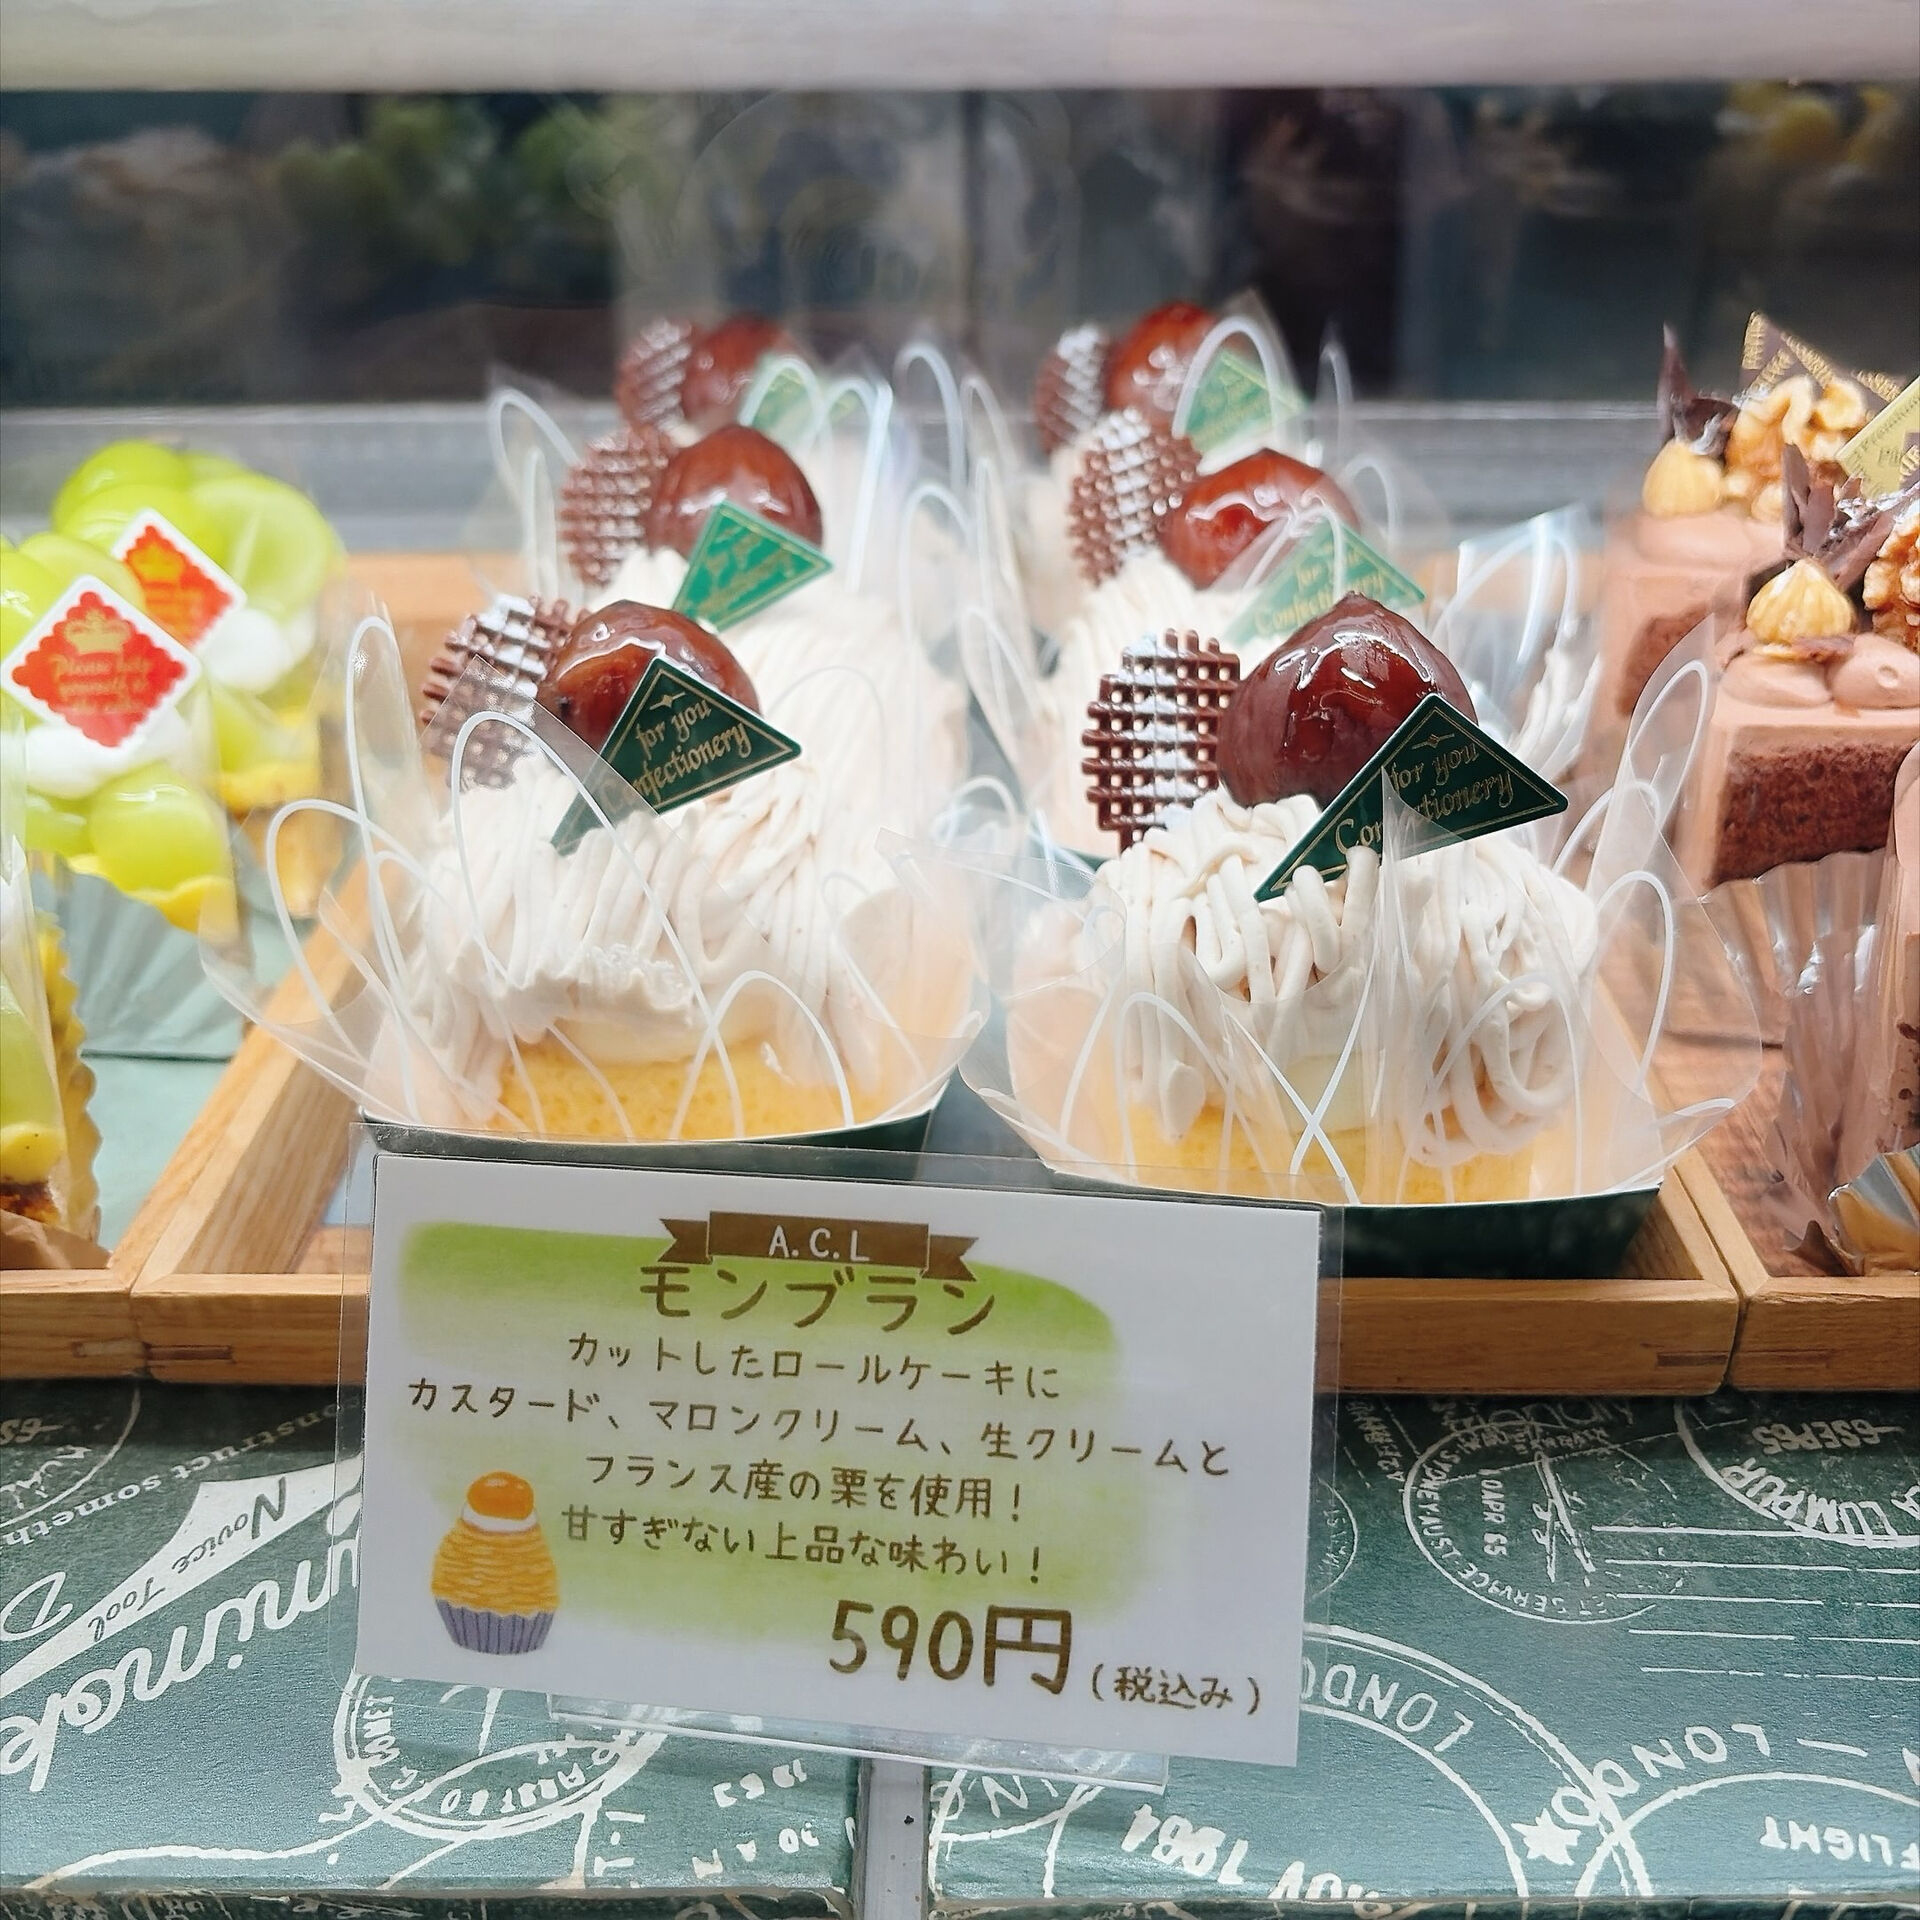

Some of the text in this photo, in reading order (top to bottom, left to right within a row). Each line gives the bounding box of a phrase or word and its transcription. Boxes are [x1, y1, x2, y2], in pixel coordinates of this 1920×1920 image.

[636, 698, 713, 760] for you
[1389, 742, 1480, 792] for you
[640, 1264, 997, 1335] モンブラン
[568, 1330, 1062, 1401] カットしたロールケーキに
[408, 1378, 1231, 1478] カスタード、マロンクリーム、生クリームと
[586, 1452, 1022, 1522] フランス産の栗を使用！
[87, 1476, 288, 1642] Novice Tool
[563, 1504, 1042, 1584] 甘すぎない上品な味わい！
[829, 1598, 1074, 1698] 590円
